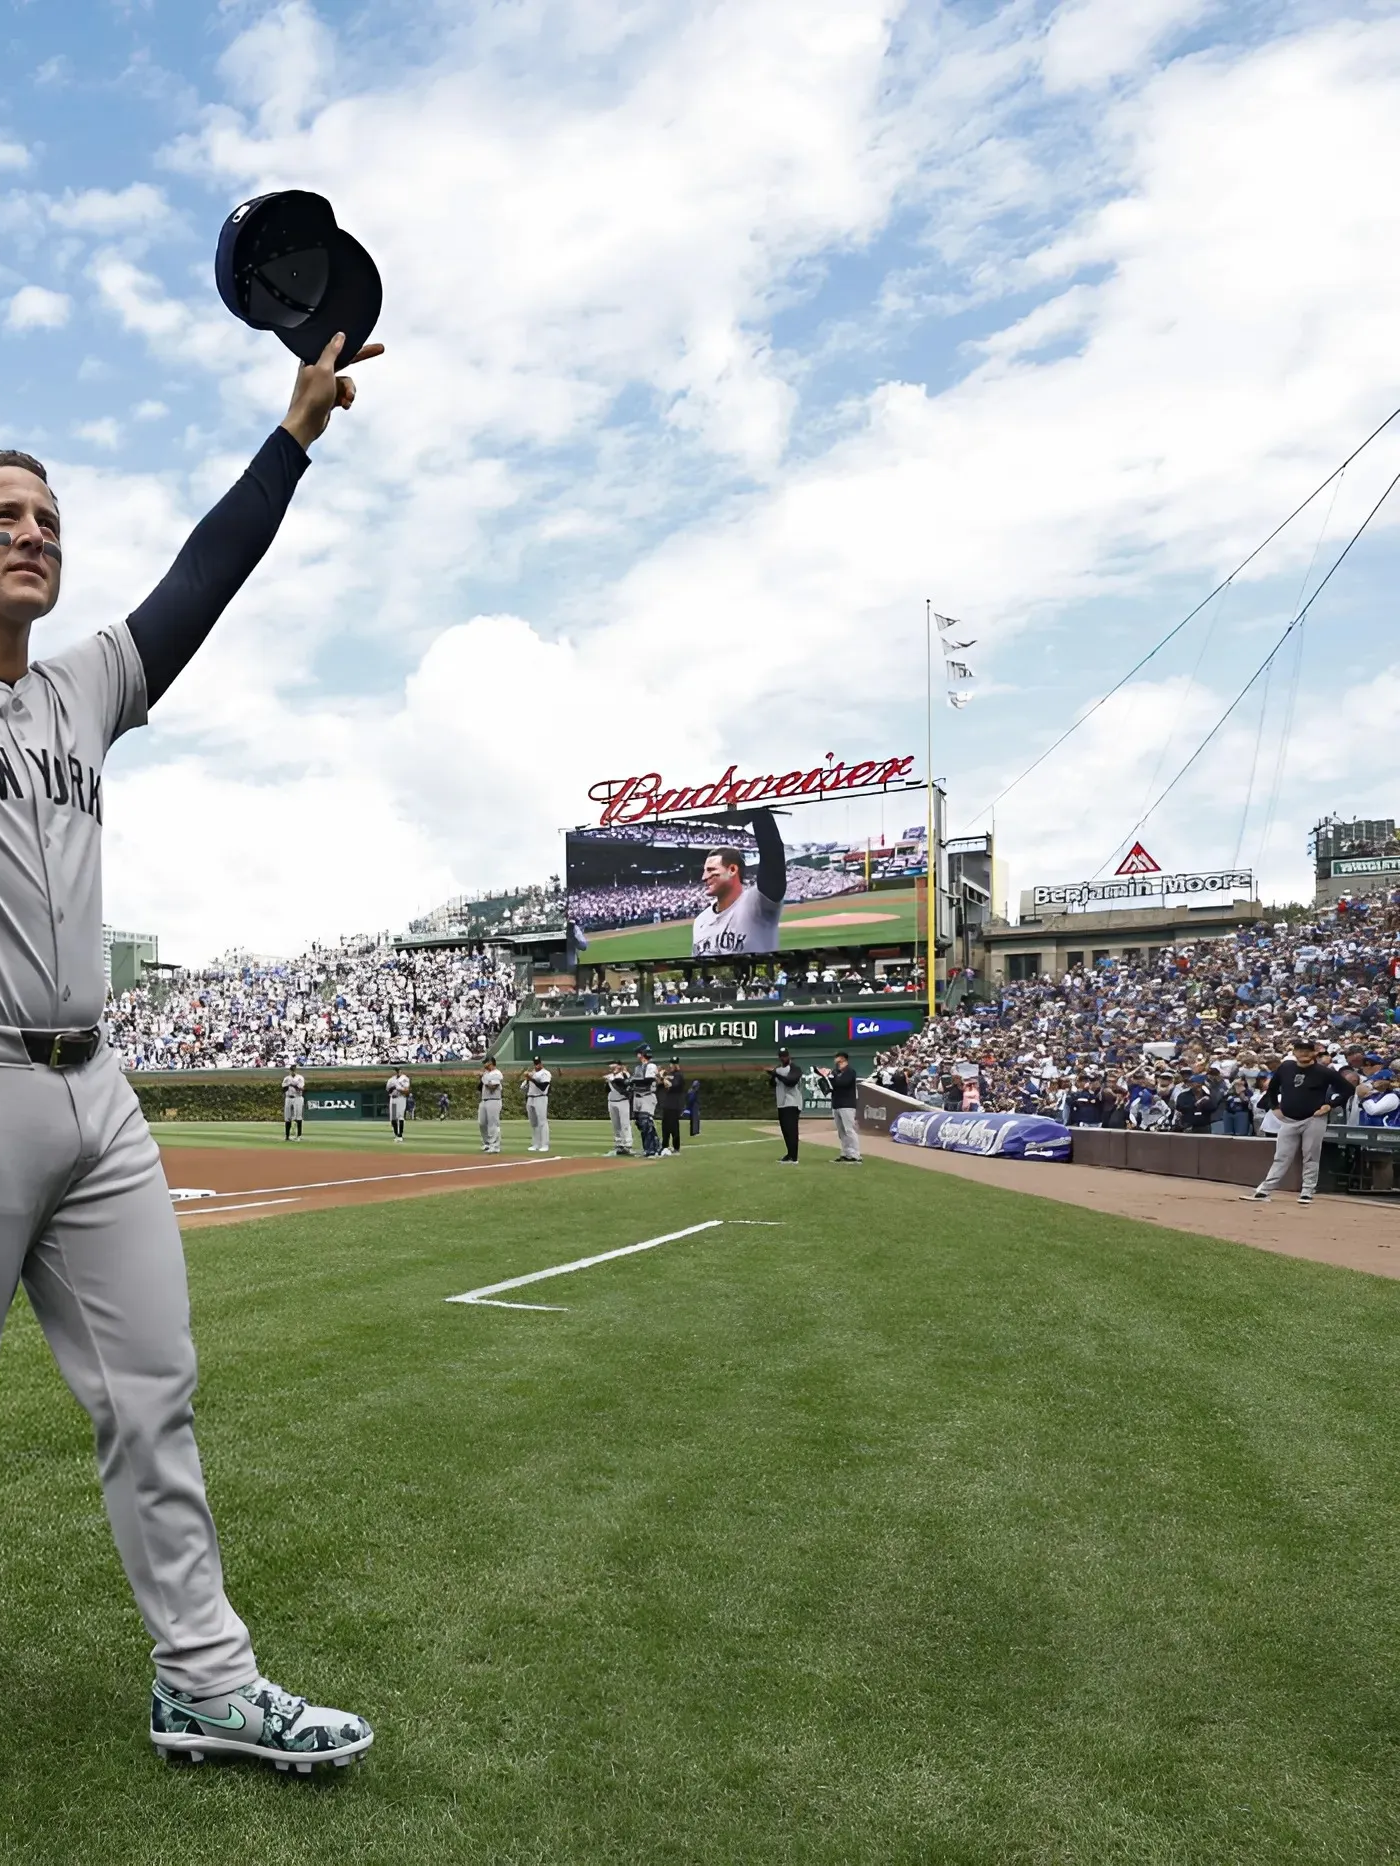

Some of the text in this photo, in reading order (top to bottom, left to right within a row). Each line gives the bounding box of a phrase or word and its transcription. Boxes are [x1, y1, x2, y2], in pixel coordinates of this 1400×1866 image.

[25, 747, 103, 827] YORK
[587, 751, 916, 826] Budweiser
[1034, 872, 1253, 906] Benjamin Moore
[657, 1020, 758, 1044] WRIGLEY FIELD
